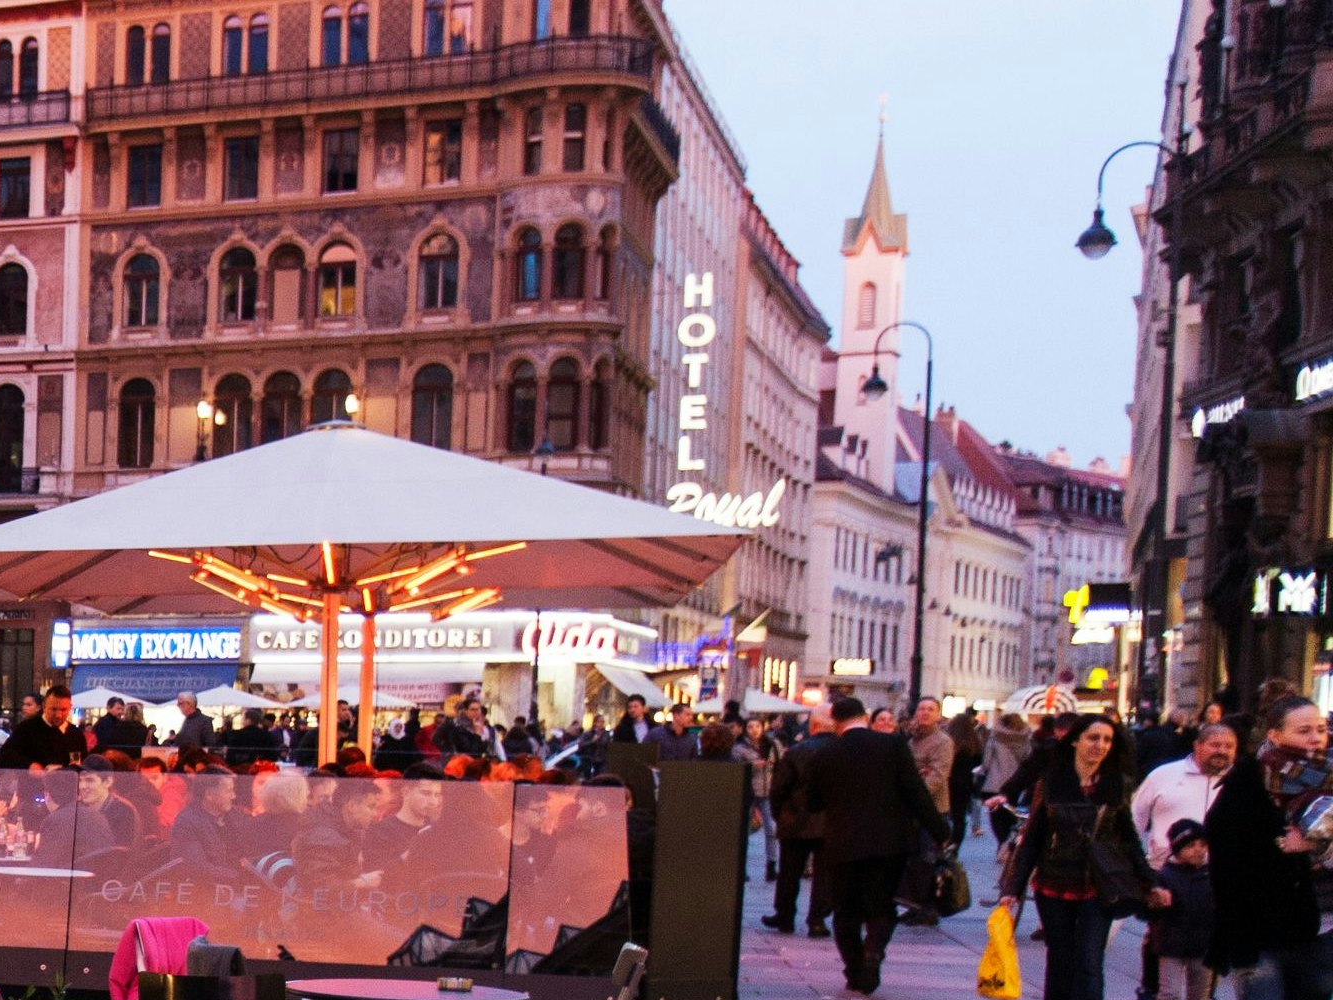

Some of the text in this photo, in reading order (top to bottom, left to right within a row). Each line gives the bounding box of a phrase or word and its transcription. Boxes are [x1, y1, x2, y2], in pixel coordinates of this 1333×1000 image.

[677, 271, 717, 471] HOTEL
[666, 478, 786, 527] Royal
[72, 632, 139, 659] MONEY
[140, 632, 241, 659] EXCHANGE
[101, 878, 195, 905] CAFÉ
[214, 884, 261, 907] DE
